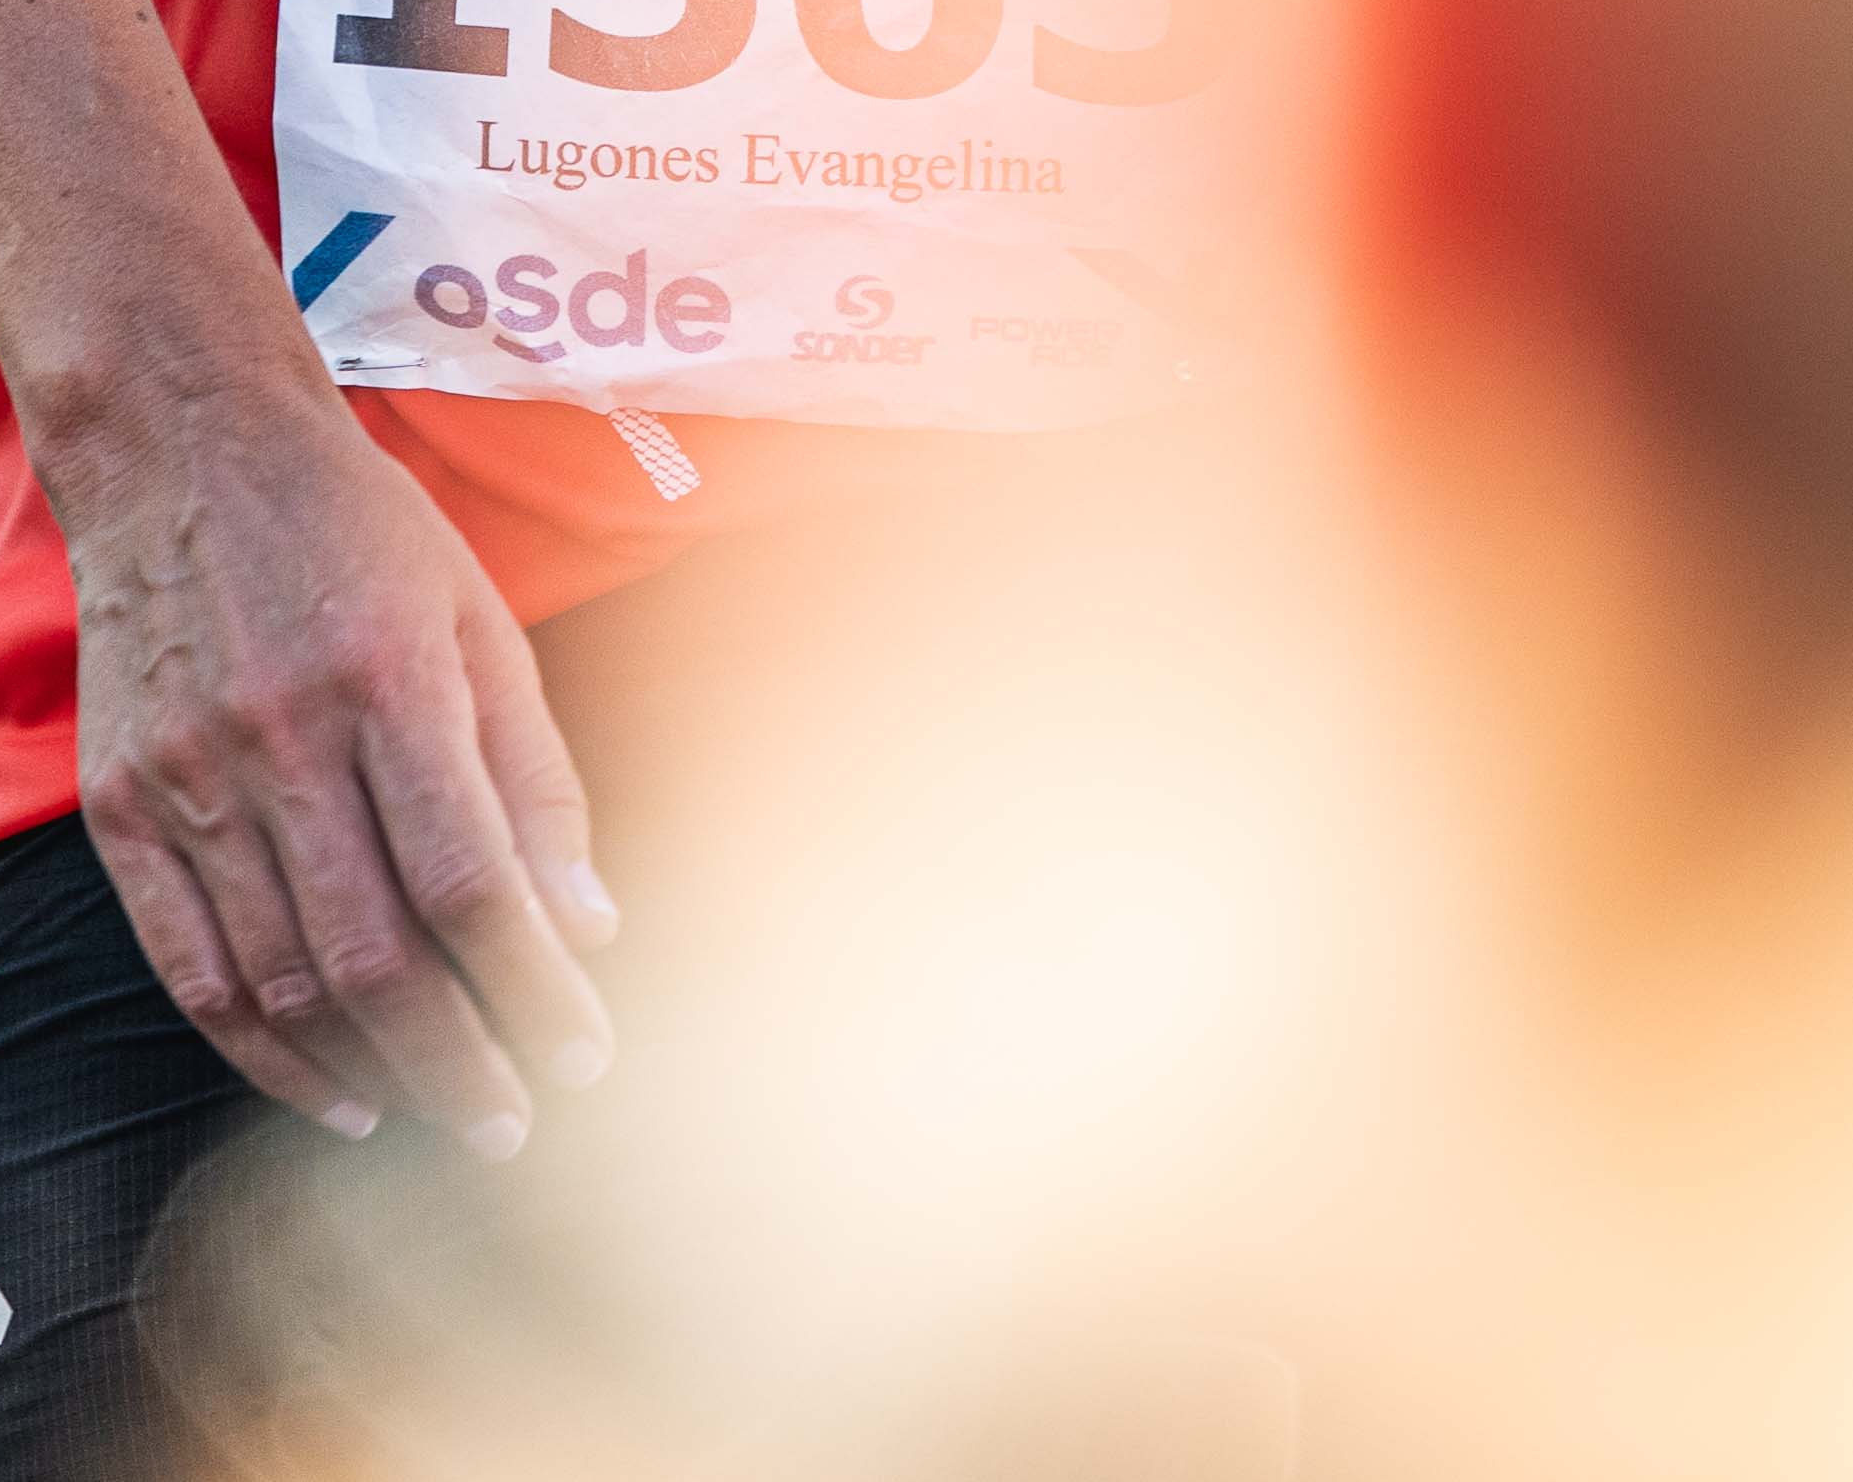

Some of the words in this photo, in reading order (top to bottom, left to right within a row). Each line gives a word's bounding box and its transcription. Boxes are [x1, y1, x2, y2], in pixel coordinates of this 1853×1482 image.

[474, 119, 720, 192] Lugones
[739, 133, 1067, 204] Evangelina
[413, 247, 732, 363] osde
